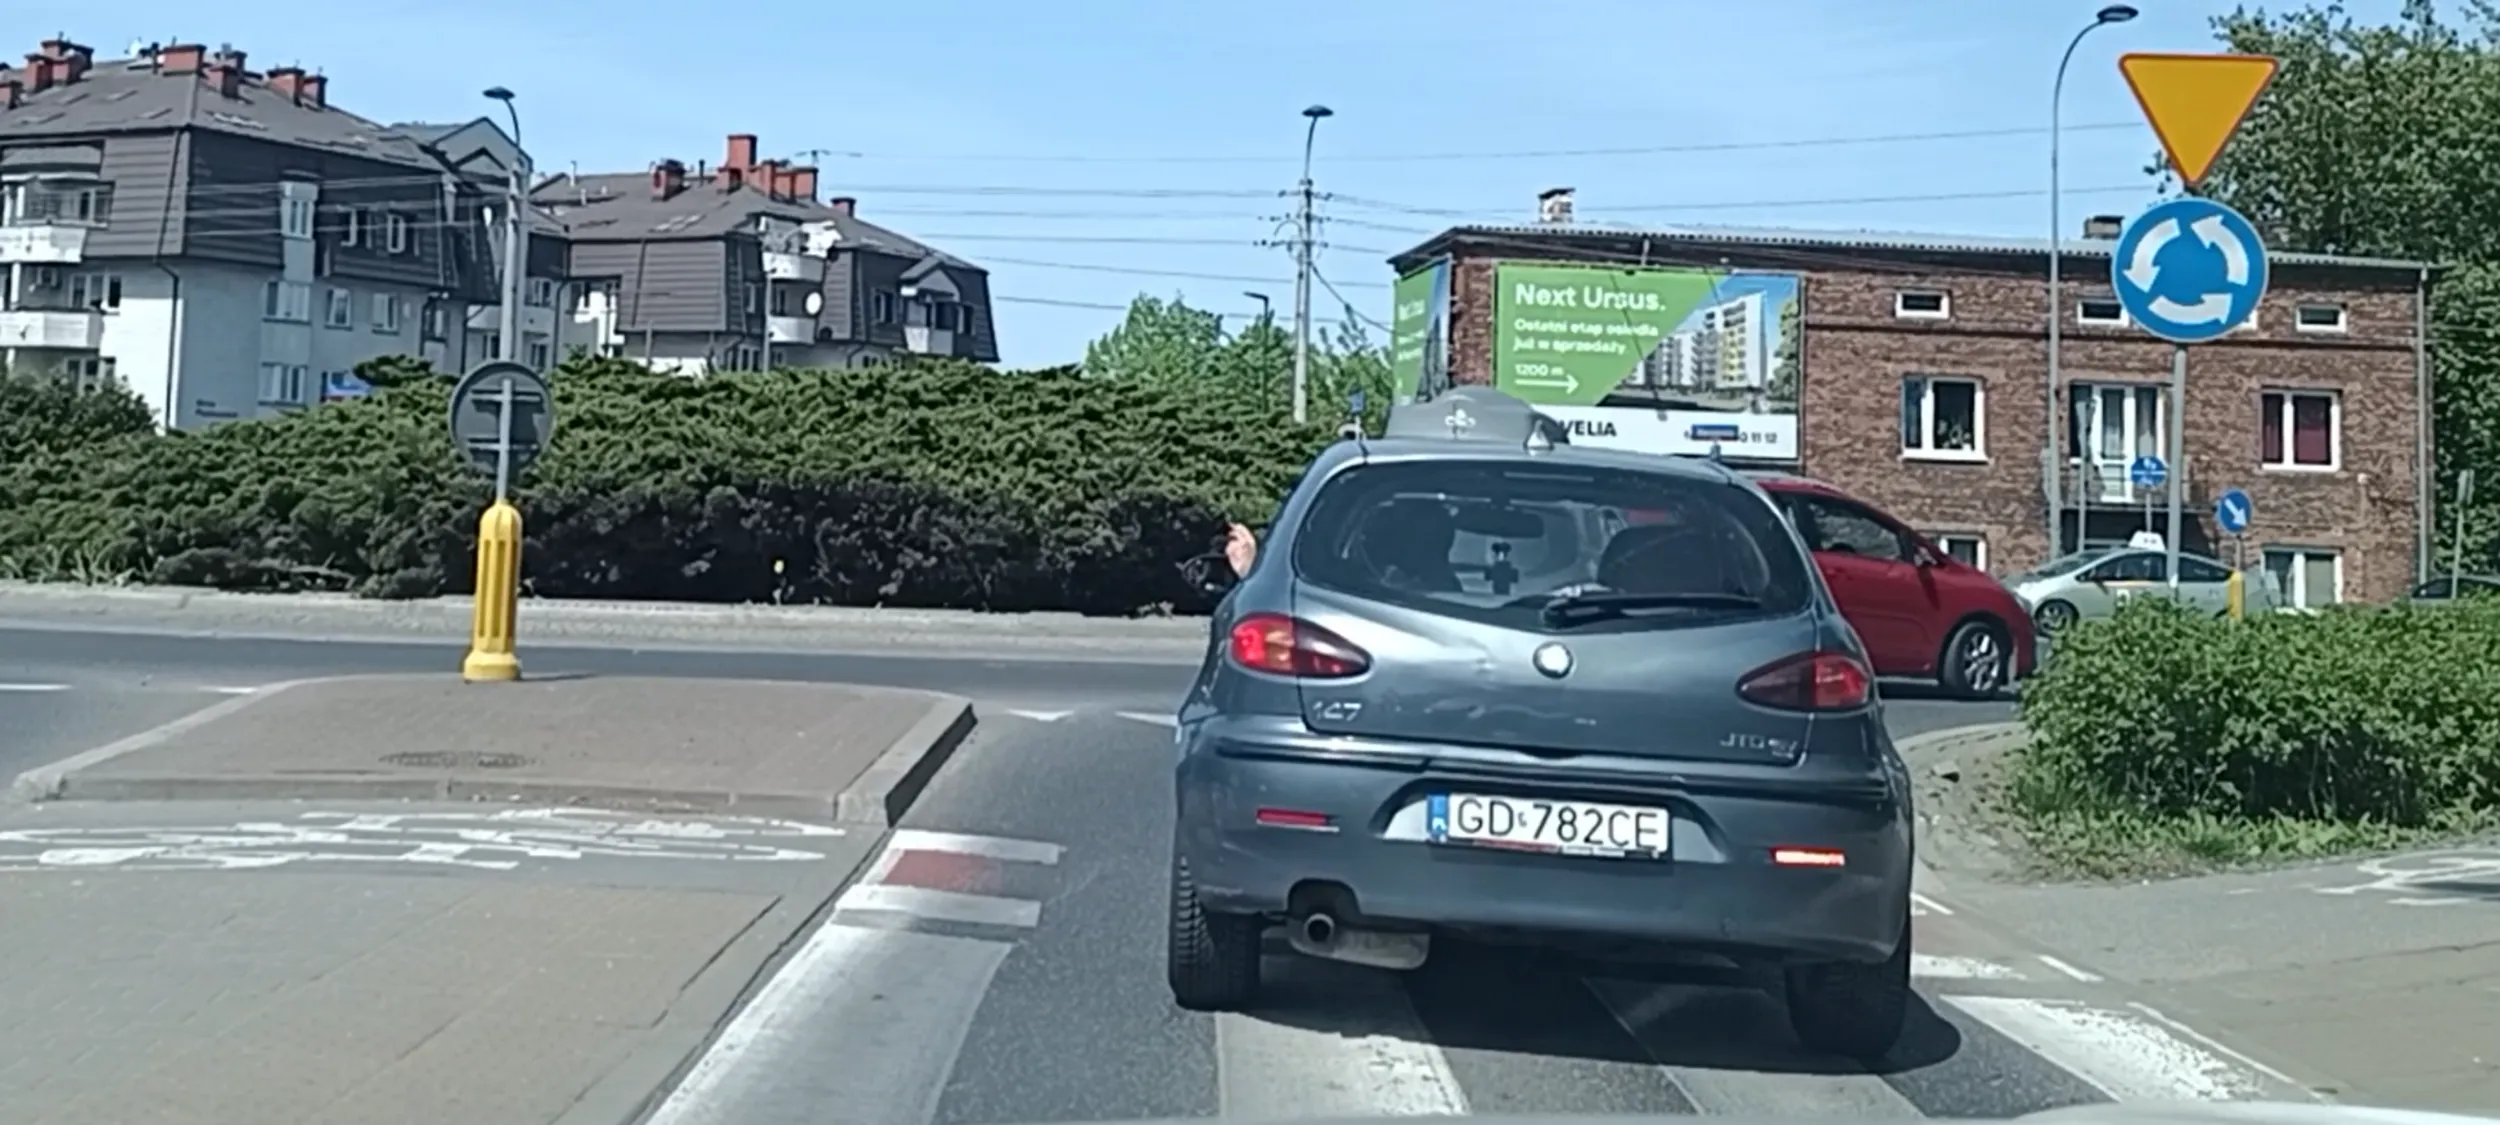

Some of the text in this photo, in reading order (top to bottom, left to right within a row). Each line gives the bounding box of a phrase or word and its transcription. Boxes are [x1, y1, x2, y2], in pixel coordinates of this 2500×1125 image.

[1515, 283, 1667, 311] Next Ursus.
[1514, 317, 1567, 333] Ostatni
[1570, 321, 1602, 336] etap
[1515, 363, 1564, 376] 1200 m
